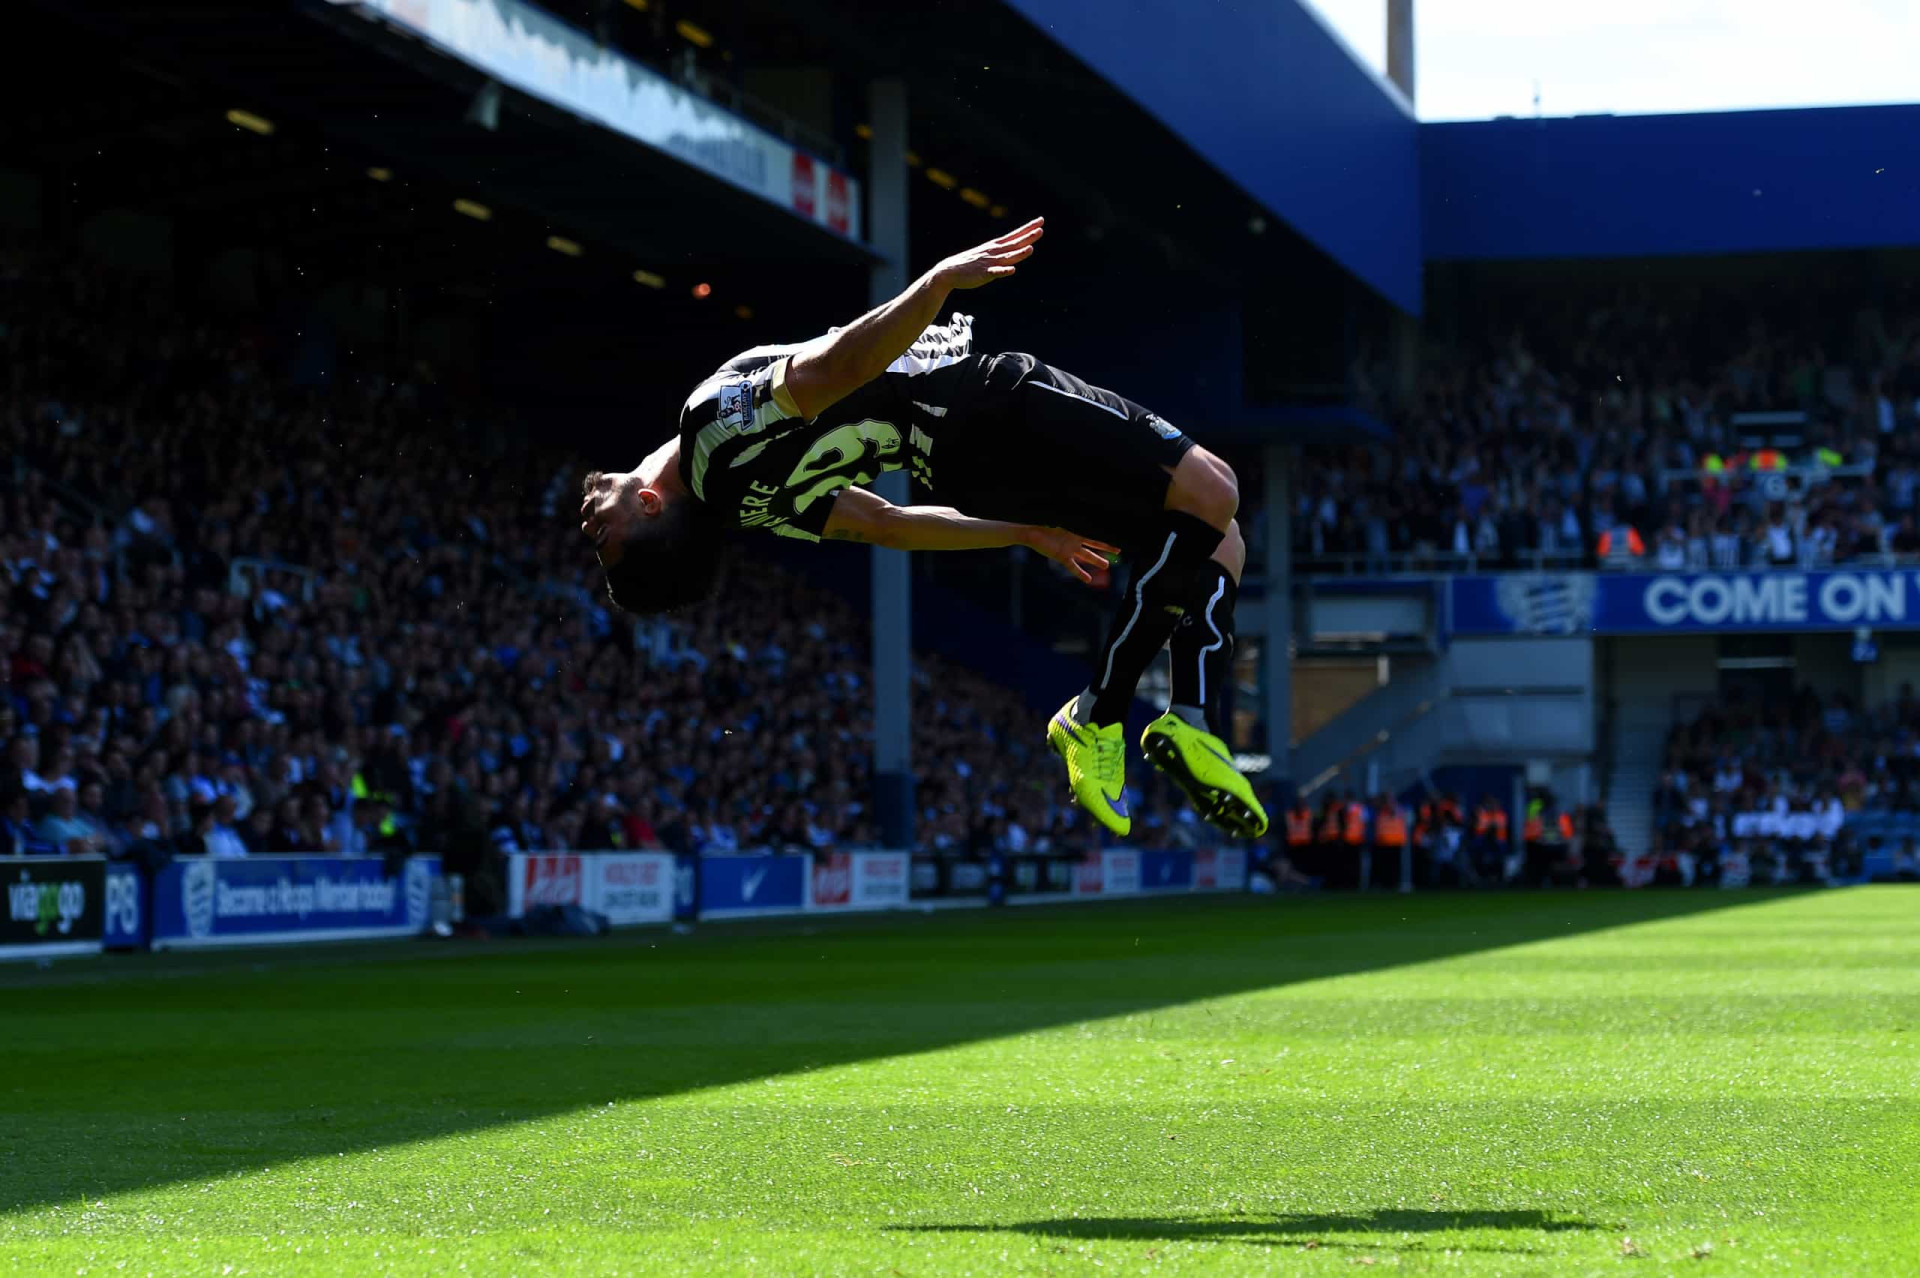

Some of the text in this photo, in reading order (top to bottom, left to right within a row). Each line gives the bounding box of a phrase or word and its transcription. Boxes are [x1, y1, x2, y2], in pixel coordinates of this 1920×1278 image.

[1644, 573, 1907, 625] COME ON
[8, 868, 84, 934] viagogo
